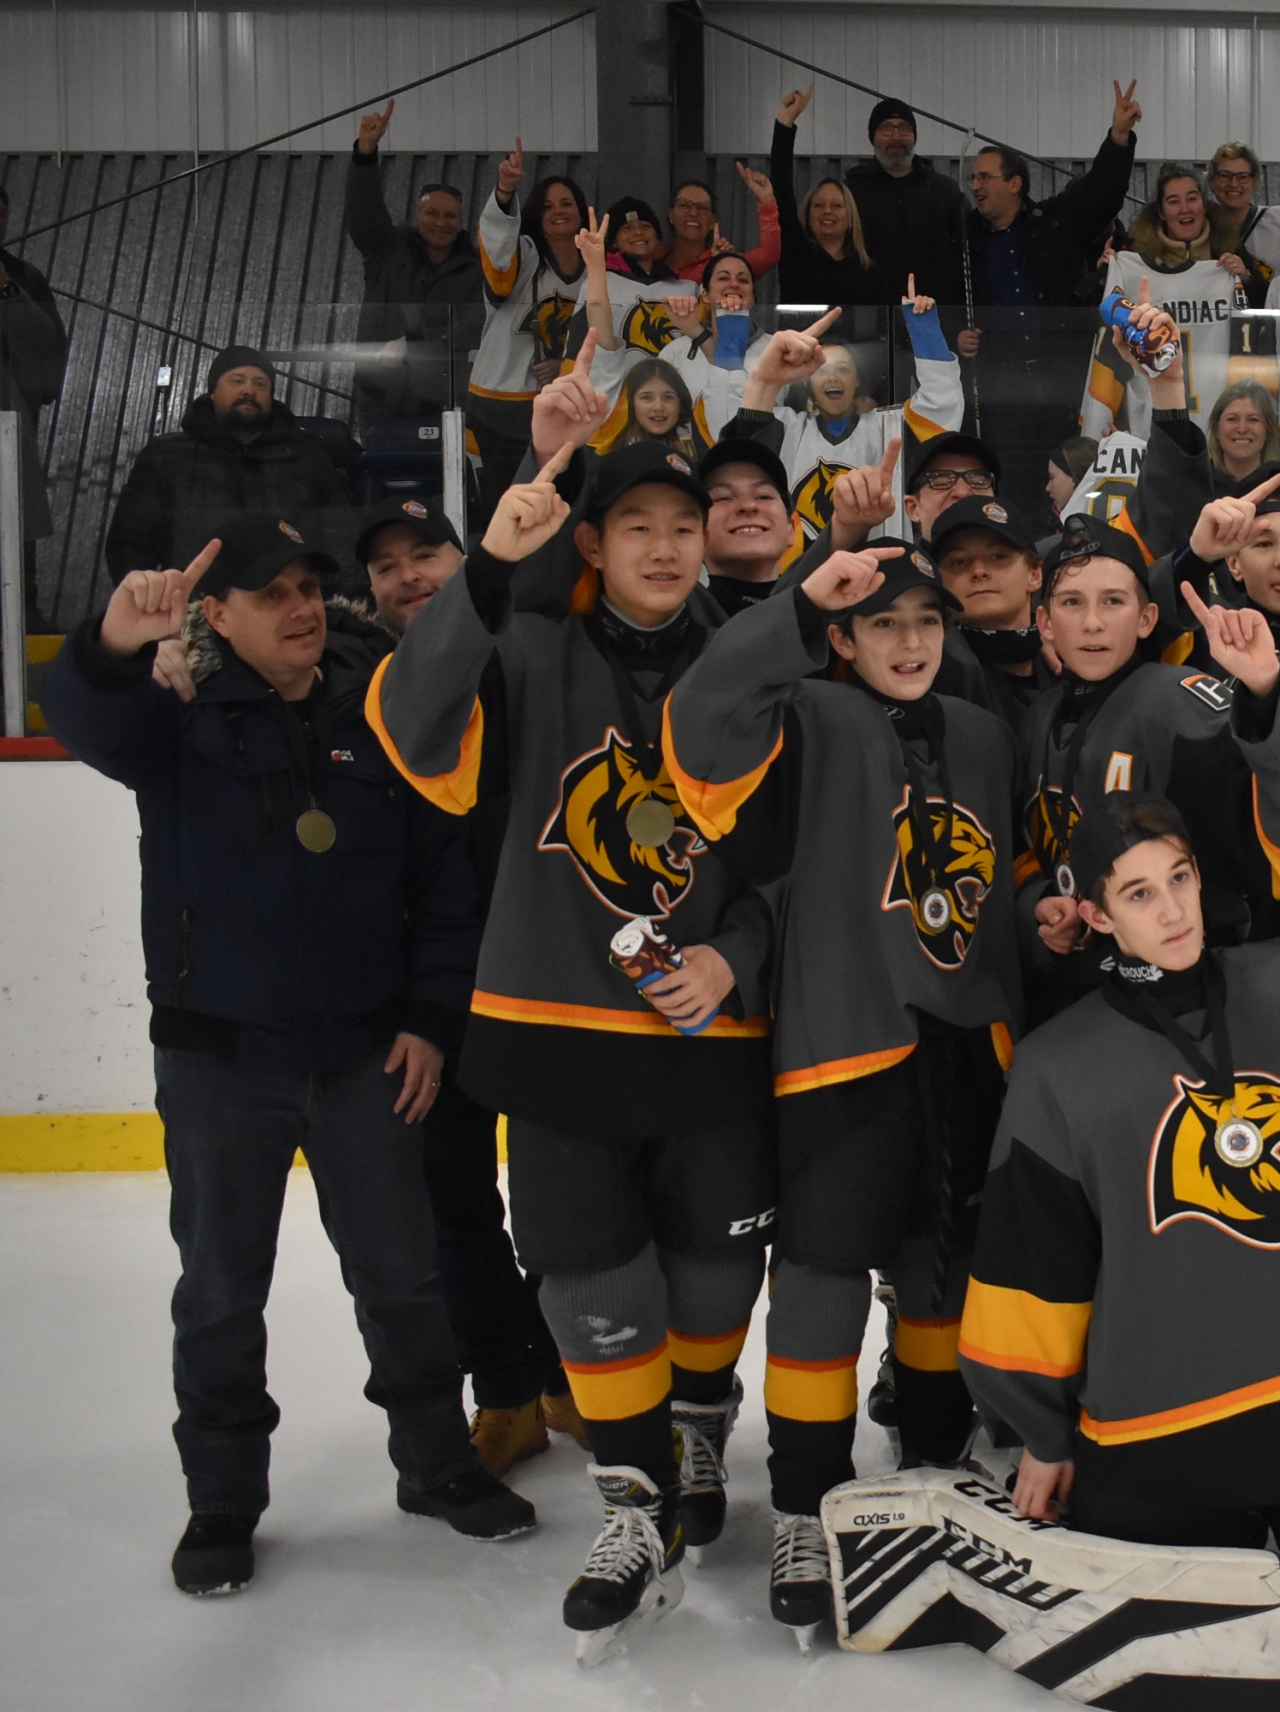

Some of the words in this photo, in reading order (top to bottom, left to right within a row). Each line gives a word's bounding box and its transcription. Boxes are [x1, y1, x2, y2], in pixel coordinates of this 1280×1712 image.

[1156, 298, 1229, 324] NDIAC
[1103, 750, 1134, 796] A
[728, 1206, 777, 1236] CC
